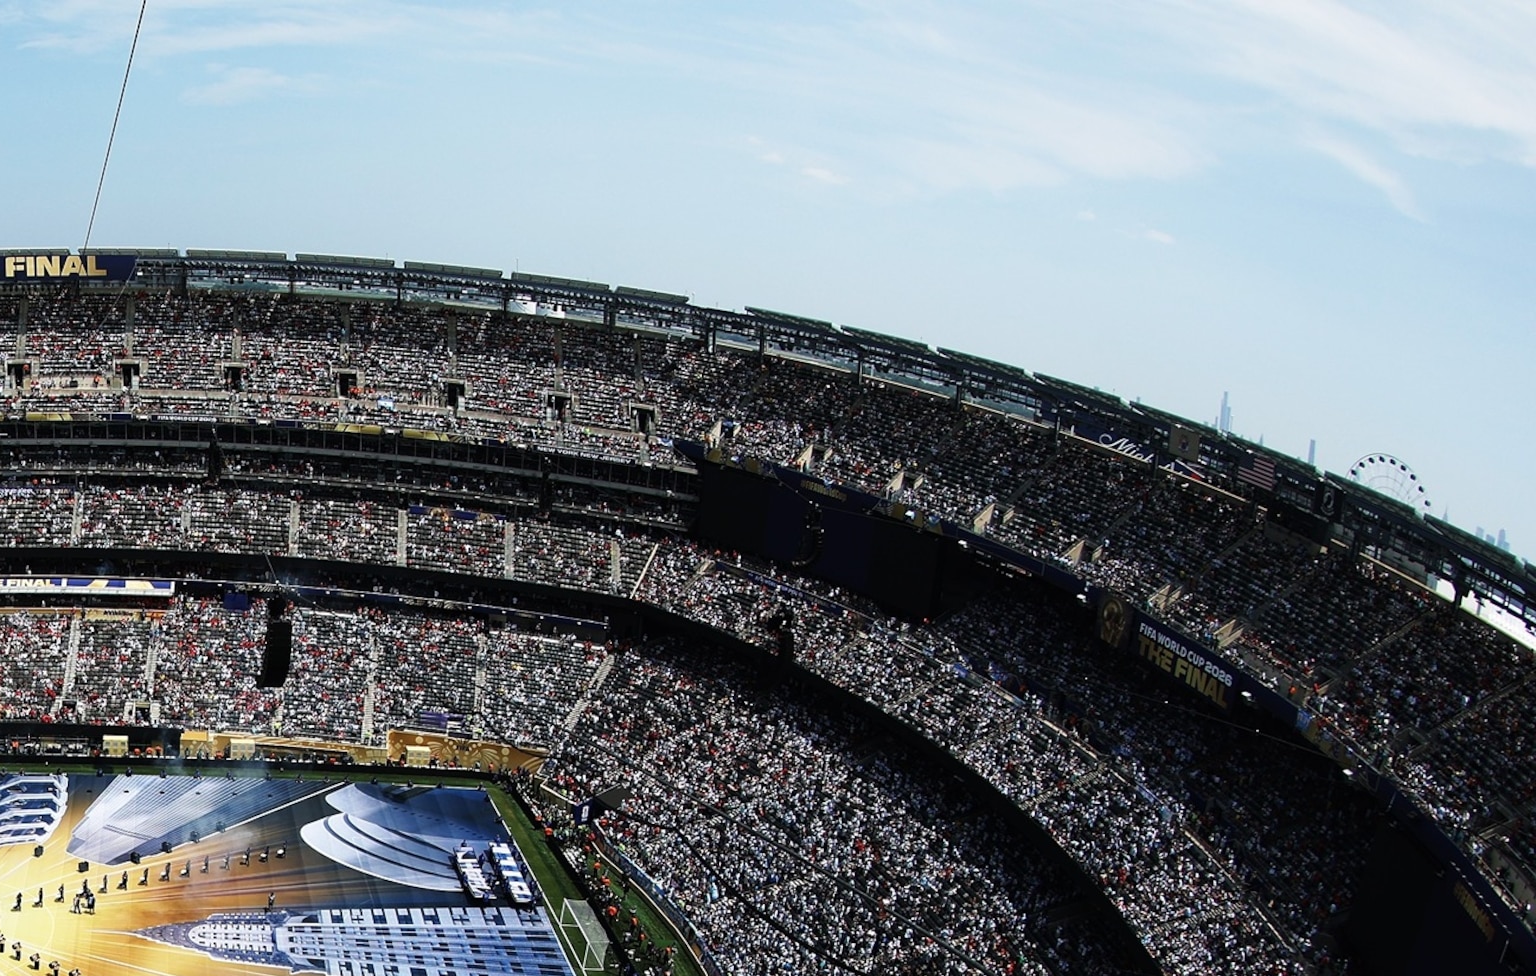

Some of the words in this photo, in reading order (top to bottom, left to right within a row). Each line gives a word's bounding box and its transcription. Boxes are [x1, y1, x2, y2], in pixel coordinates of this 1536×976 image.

[5, 255, 107, 278] FINAL
[557, 448, 578, 456] YORK
[599, 455, 631, 464] JERSEY
[6, 578, 55, 587] FINAL
[1139, 623, 1156, 640] FIFA
[1157, 632, 1187, 657] WORLD
[1187, 651, 1205, 667] CUP
[1205, 661, 1233, 687] 2026
[1138, 633, 1174, 673] THE
[1174, 658, 1228, 709] FINAL
